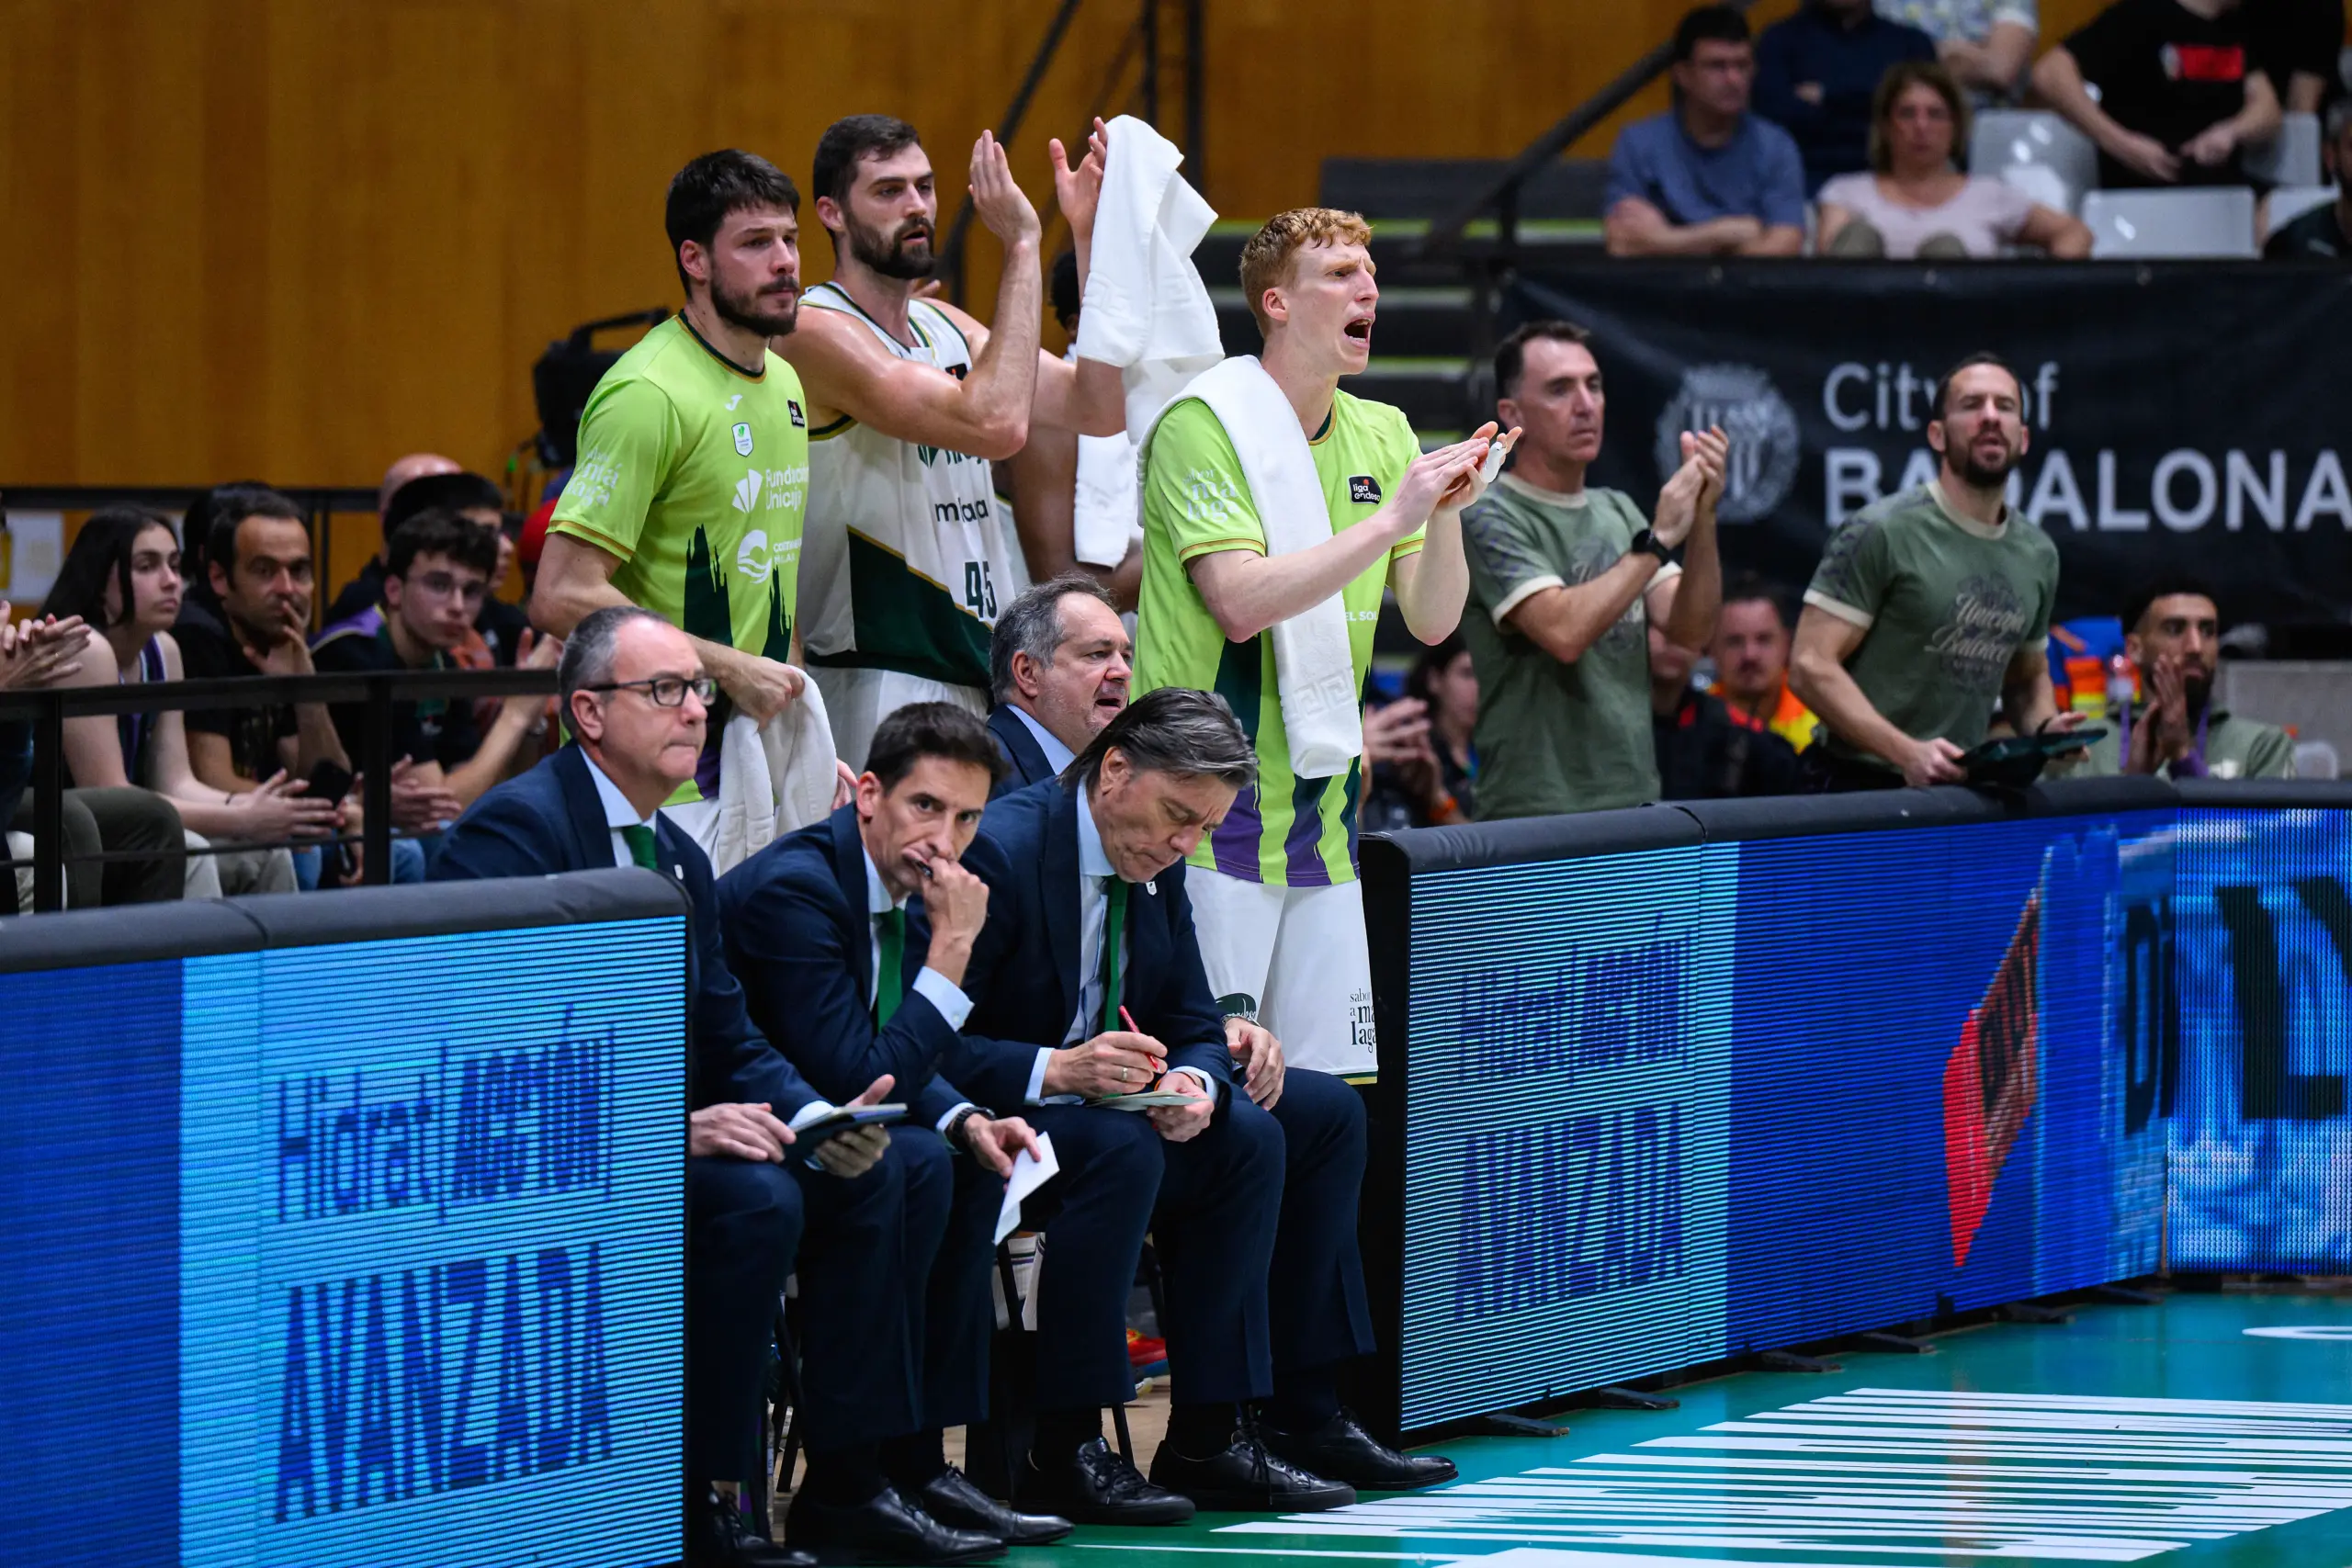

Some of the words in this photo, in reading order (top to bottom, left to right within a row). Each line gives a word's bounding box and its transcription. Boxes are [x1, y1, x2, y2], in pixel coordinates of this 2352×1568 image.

[2021, 361, 2059, 432] f
[1352, 483, 1369, 493] liga
[1353, 491, 1381, 502] endesa
[1825, 448, 2352, 531] BAALONA
[1455, 1099, 1685, 1324] AVANZADA
[275, 1240, 614, 1528] AVANZADA
